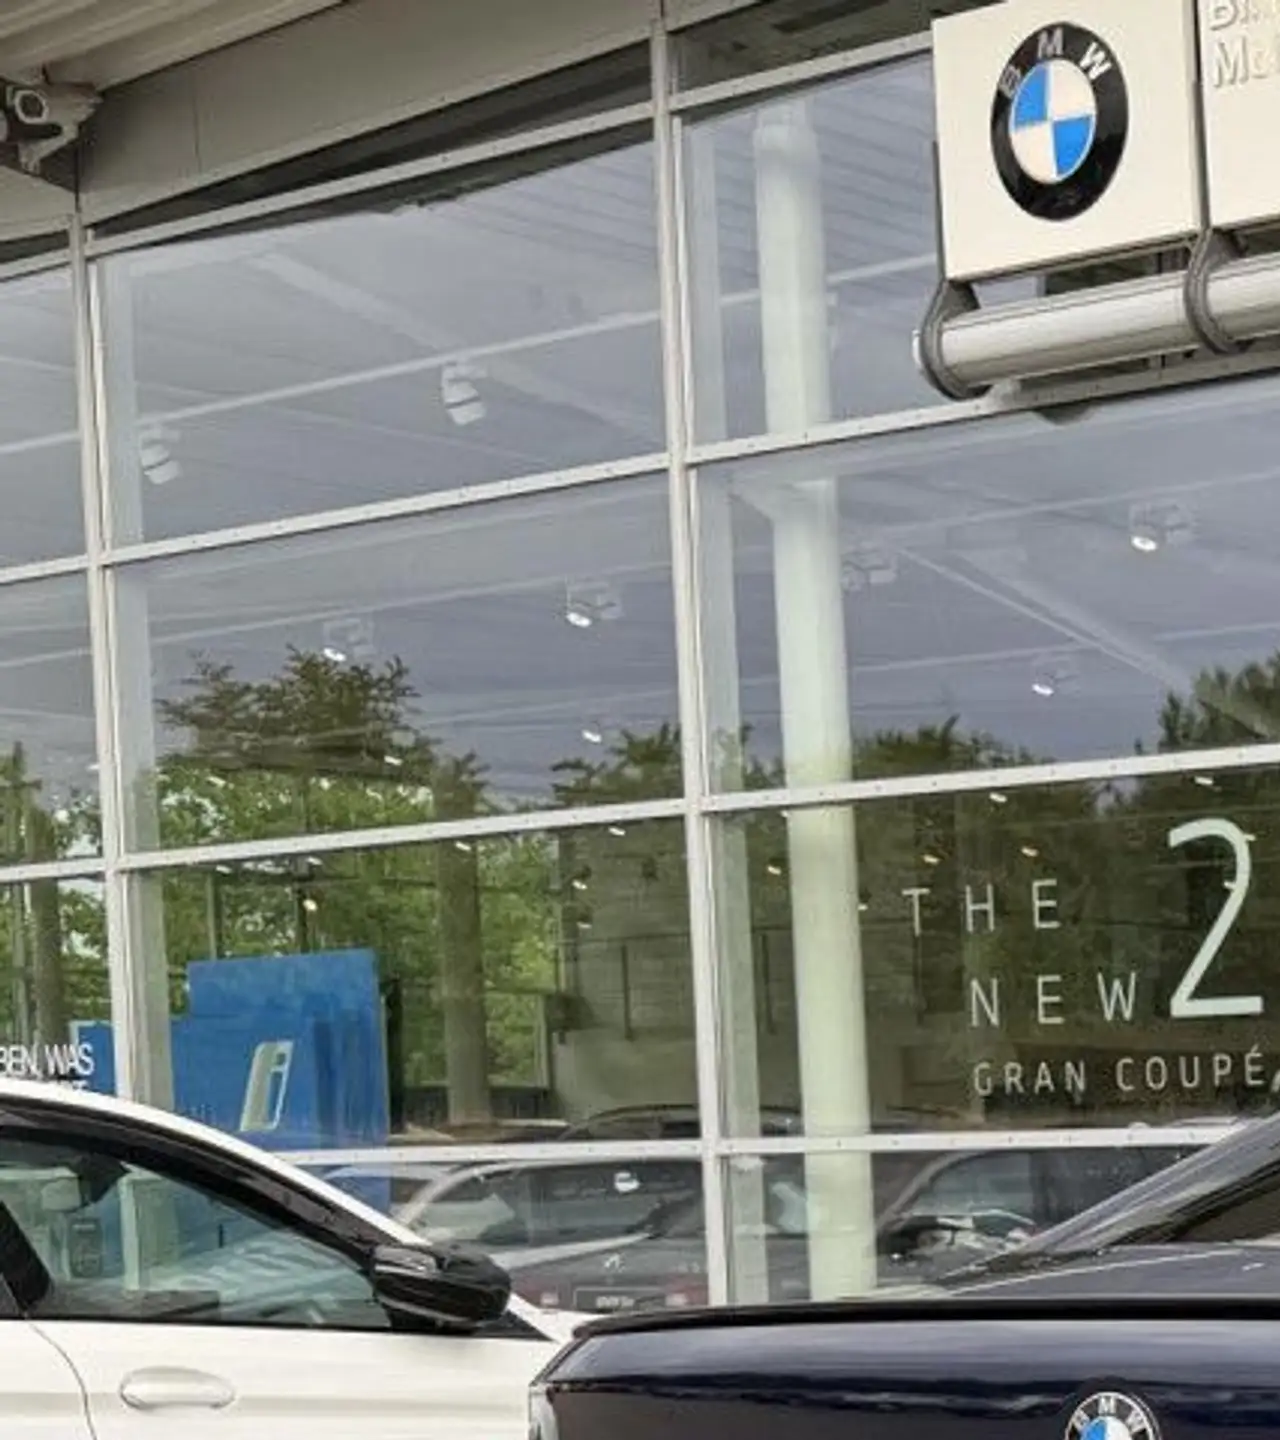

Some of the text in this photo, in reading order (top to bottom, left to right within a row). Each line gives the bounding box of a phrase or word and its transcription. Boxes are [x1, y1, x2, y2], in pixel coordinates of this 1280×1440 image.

[998, 26, 1112, 100] BMW
[902, 878, 1062, 936] THE
[1168, 817, 1264, 1019] 2
[970, 971, 1137, 1027] NEW
[44, 1042, 95, 1076] WAS
[973, 1059, 1087, 1097] GRAN
